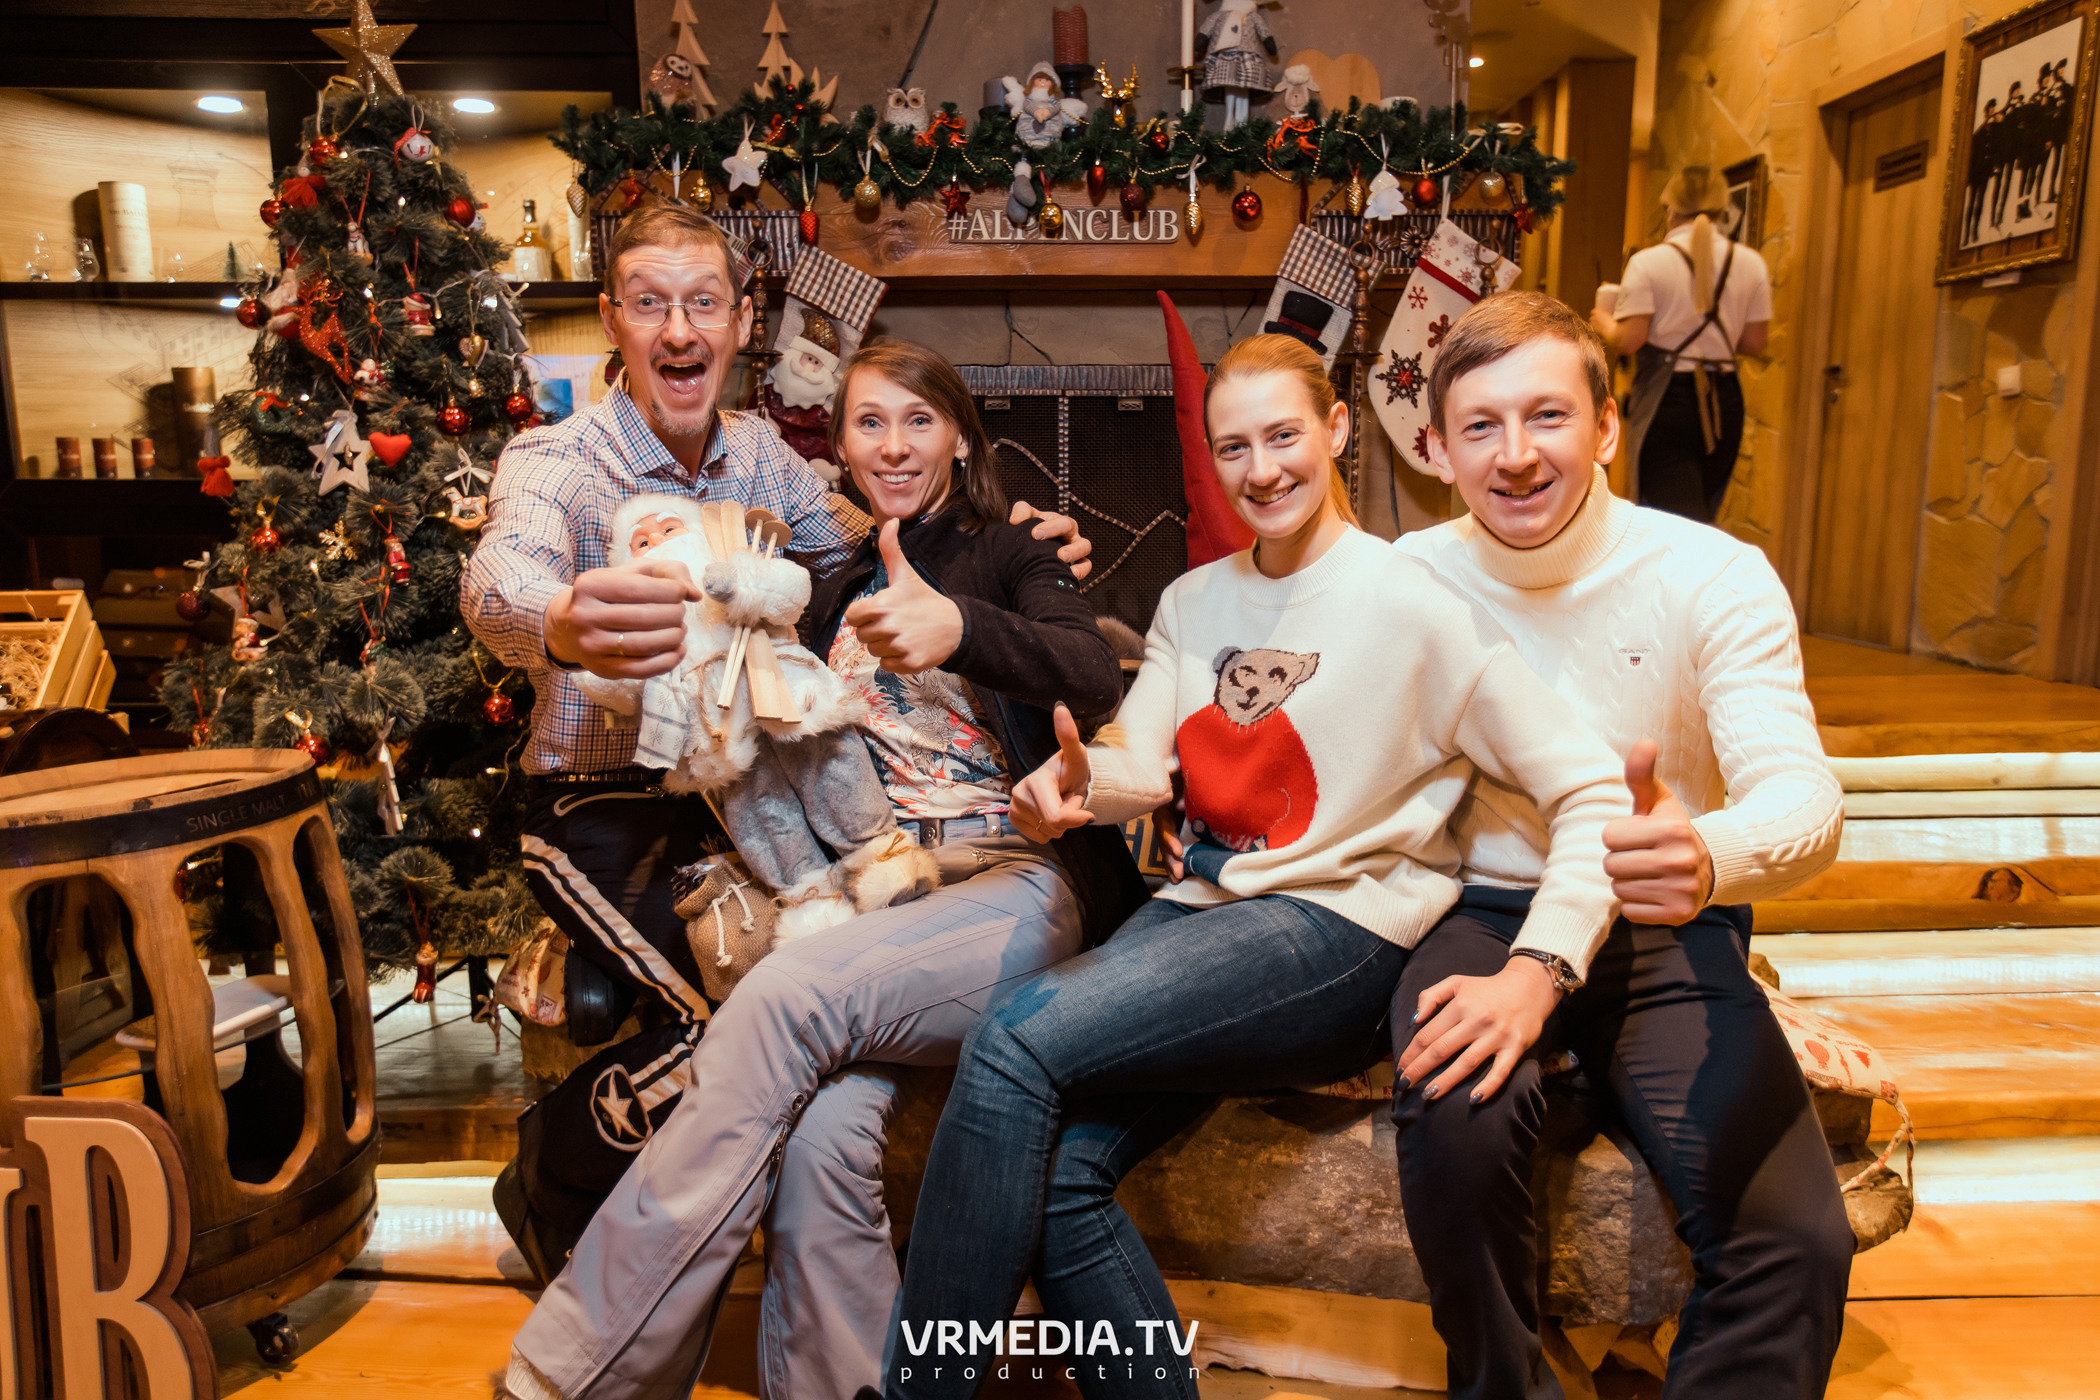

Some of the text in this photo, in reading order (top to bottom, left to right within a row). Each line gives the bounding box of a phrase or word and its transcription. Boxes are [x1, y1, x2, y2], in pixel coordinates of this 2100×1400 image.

[948, 208, 1179, 241] #ALNCLUB
[186, 794, 286, 833] SINGLE MALT
